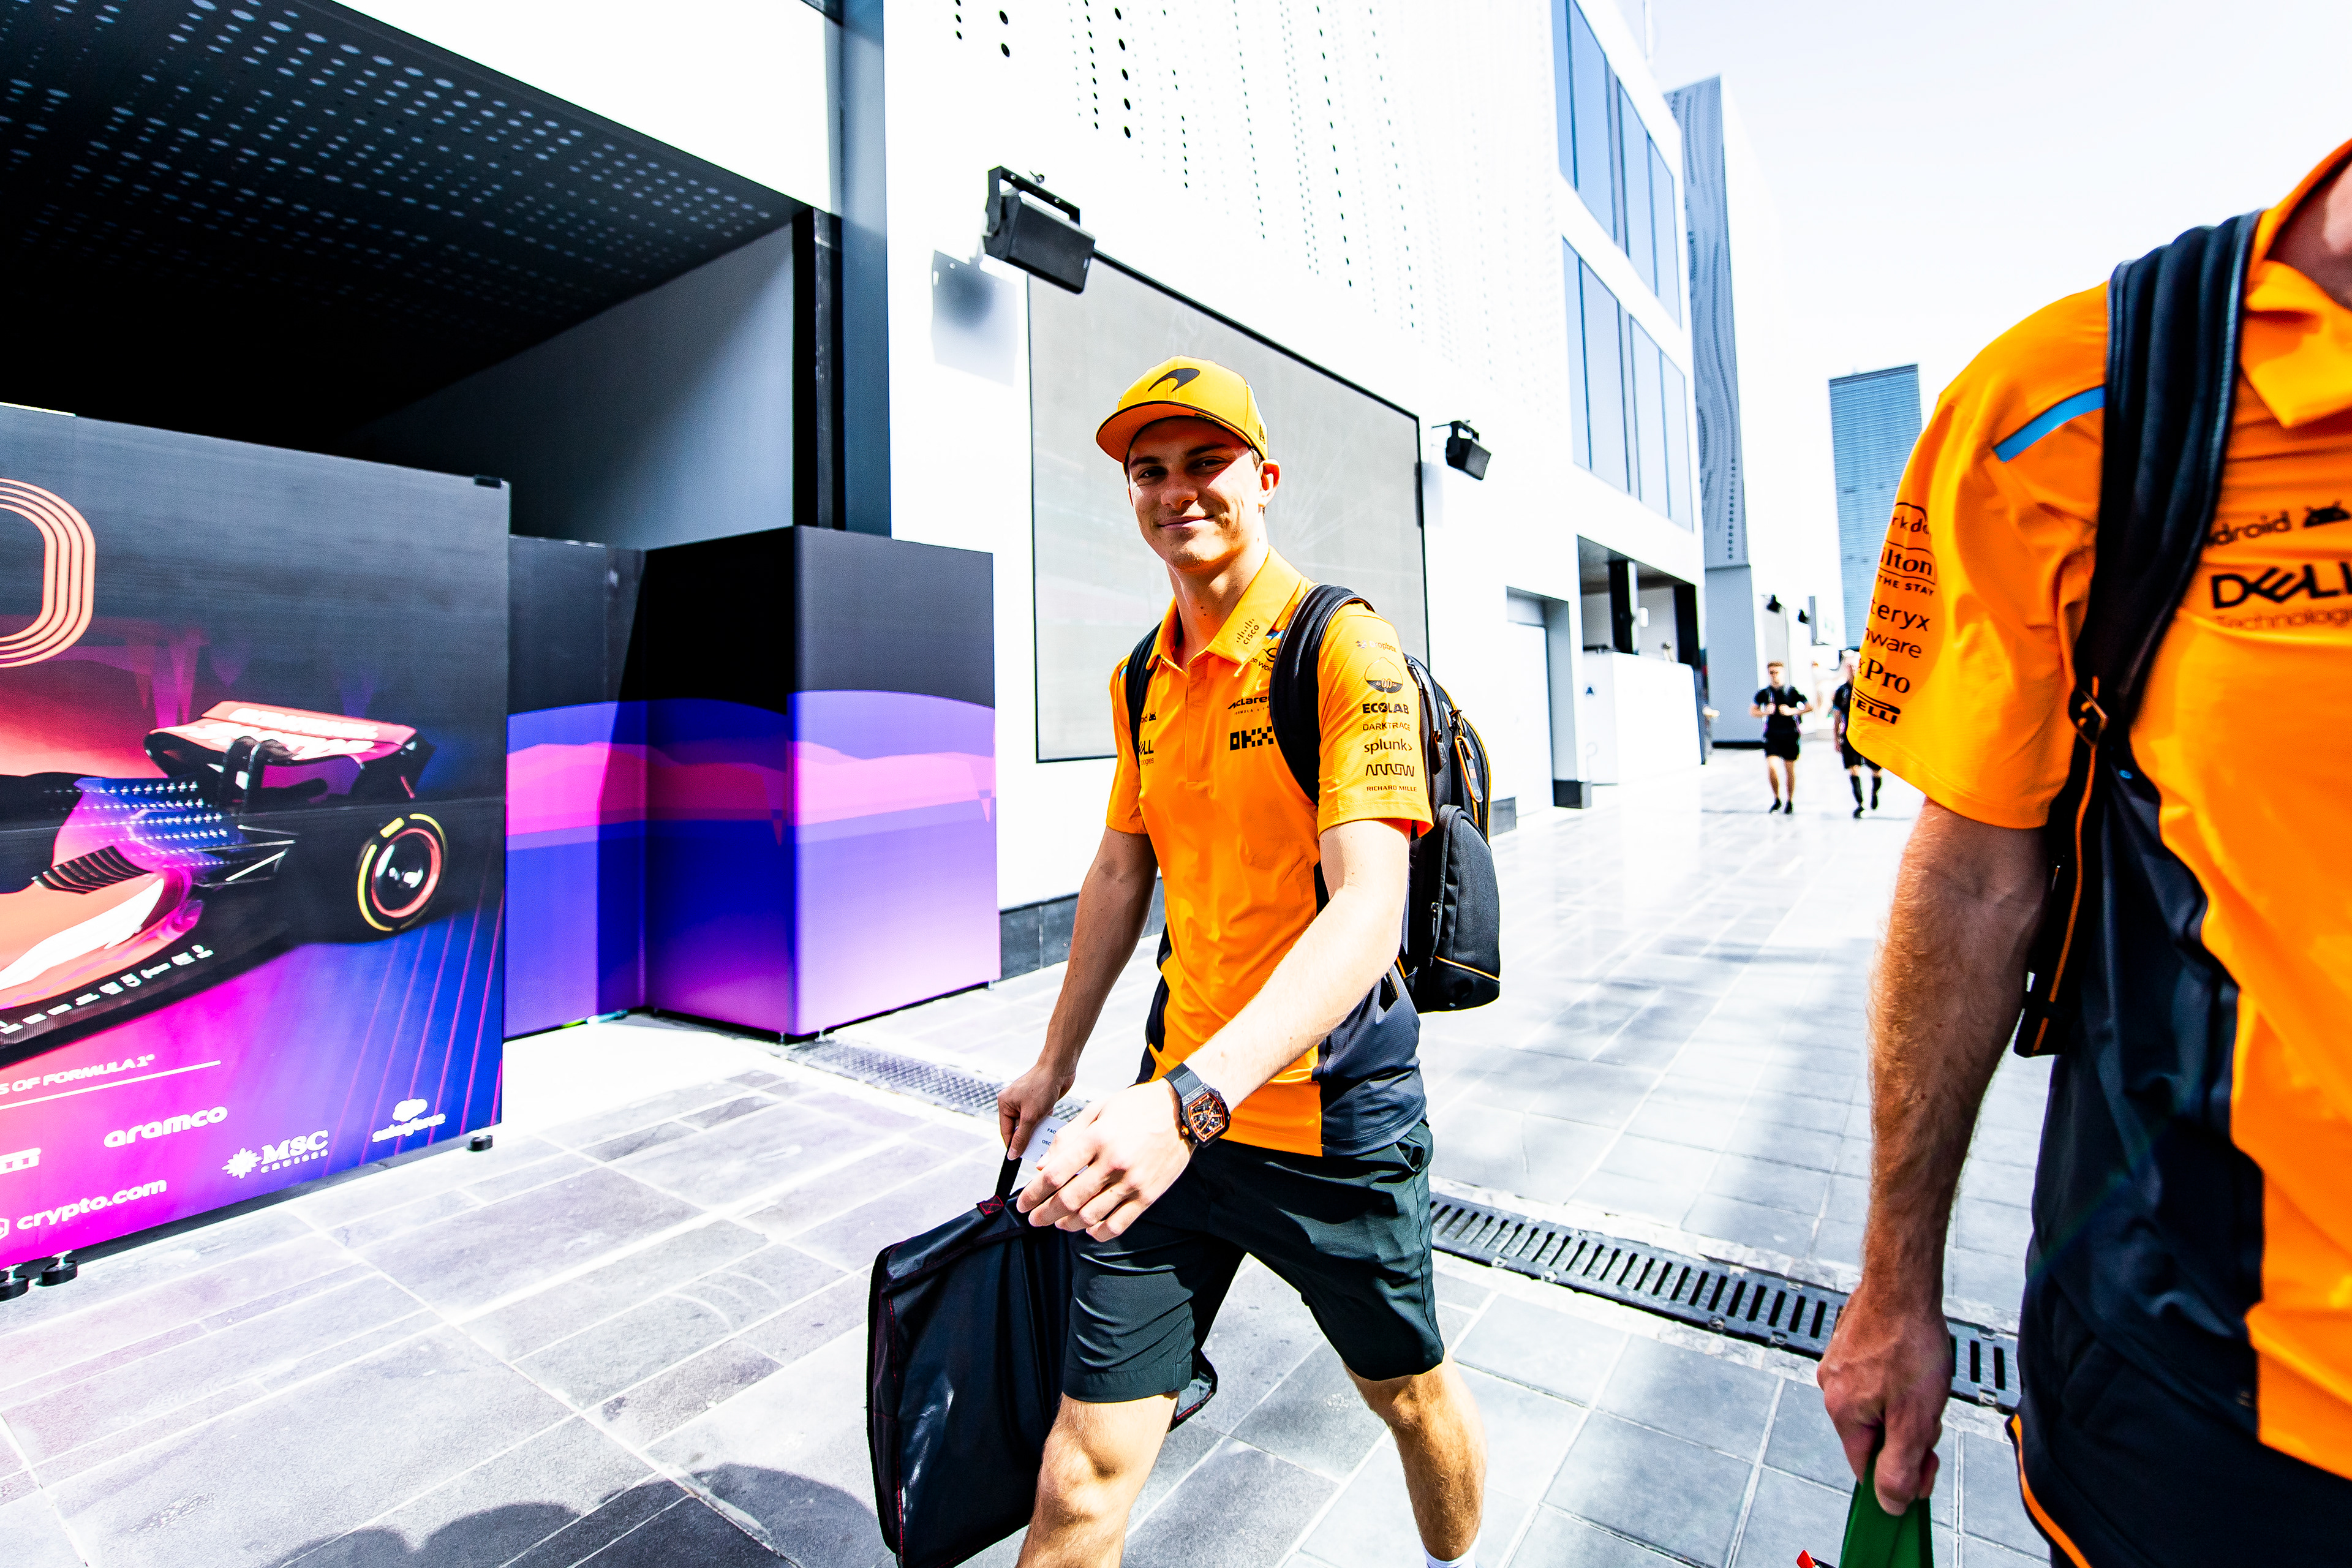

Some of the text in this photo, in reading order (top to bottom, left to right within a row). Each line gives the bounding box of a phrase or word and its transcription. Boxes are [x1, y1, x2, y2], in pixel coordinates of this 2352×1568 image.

[2205, 510, 2292, 549] droid
[1880, 547, 1932, 576] ilton
[1878, 574, 1934, 597] THE STAY
[1871, 597, 1931, 632] teryx
[1243, 625, 1259, 645] CISCO
[1866, 627, 1922, 658] ware
[1258, 662, 1273, 673] WOR
[1859, 657, 1910, 693] xPro
[1227, 696, 1270, 709] McLare
[1362, 703, 1409, 715] ECOLAB
[1852, 690, 1899, 725] ELLI
[1229, 726, 1274, 751] OKX
[1363, 722, 1411, 731] DARKTRACE
[1365, 764, 1414, 777] ARROW
[12, 1077, 41, 1092] OF
[42, 1058, 137, 1086] FORMULA
[104, 1106, 228, 1148] aramco
[260, 1129, 329, 1165] MSC
[17, 1179, 167, 1230] crypto.com
